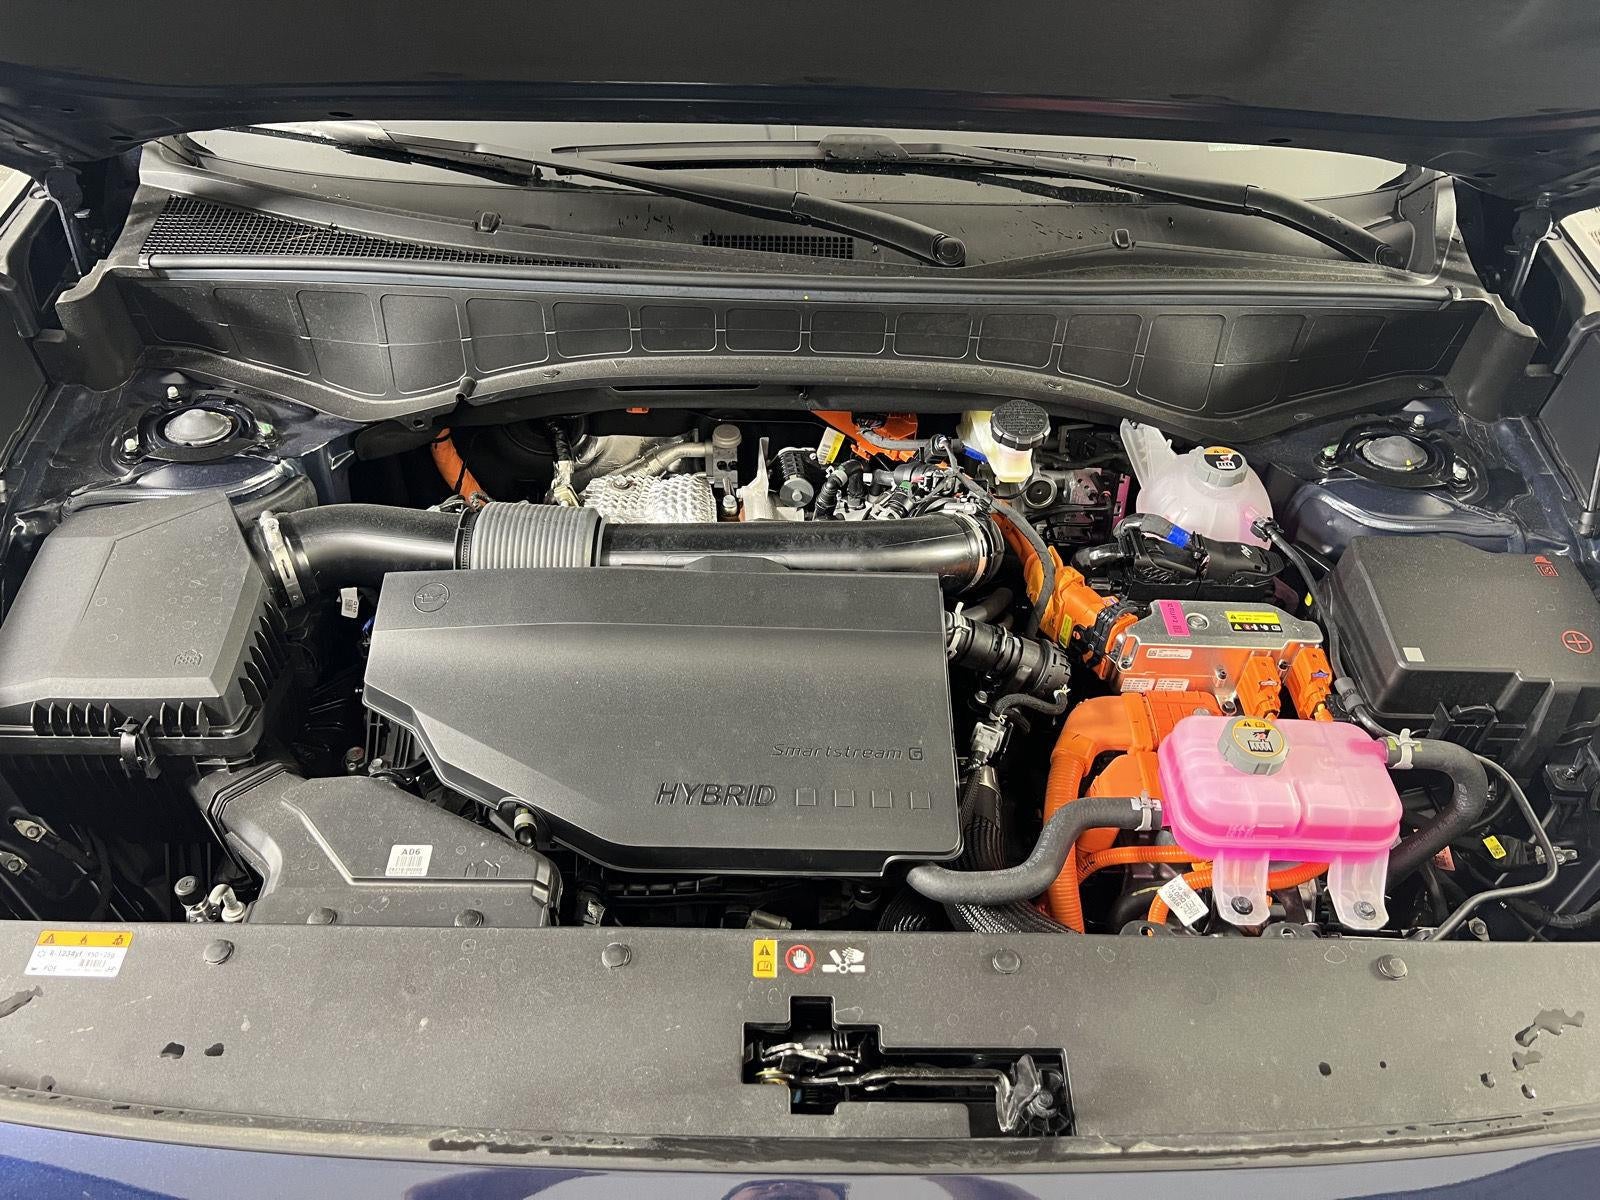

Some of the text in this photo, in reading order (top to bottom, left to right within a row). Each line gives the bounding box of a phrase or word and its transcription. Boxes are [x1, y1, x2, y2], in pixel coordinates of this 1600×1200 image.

[771, 743, 924, 761] Smartstream G
[655, 782, 777, 807] HYBRID
